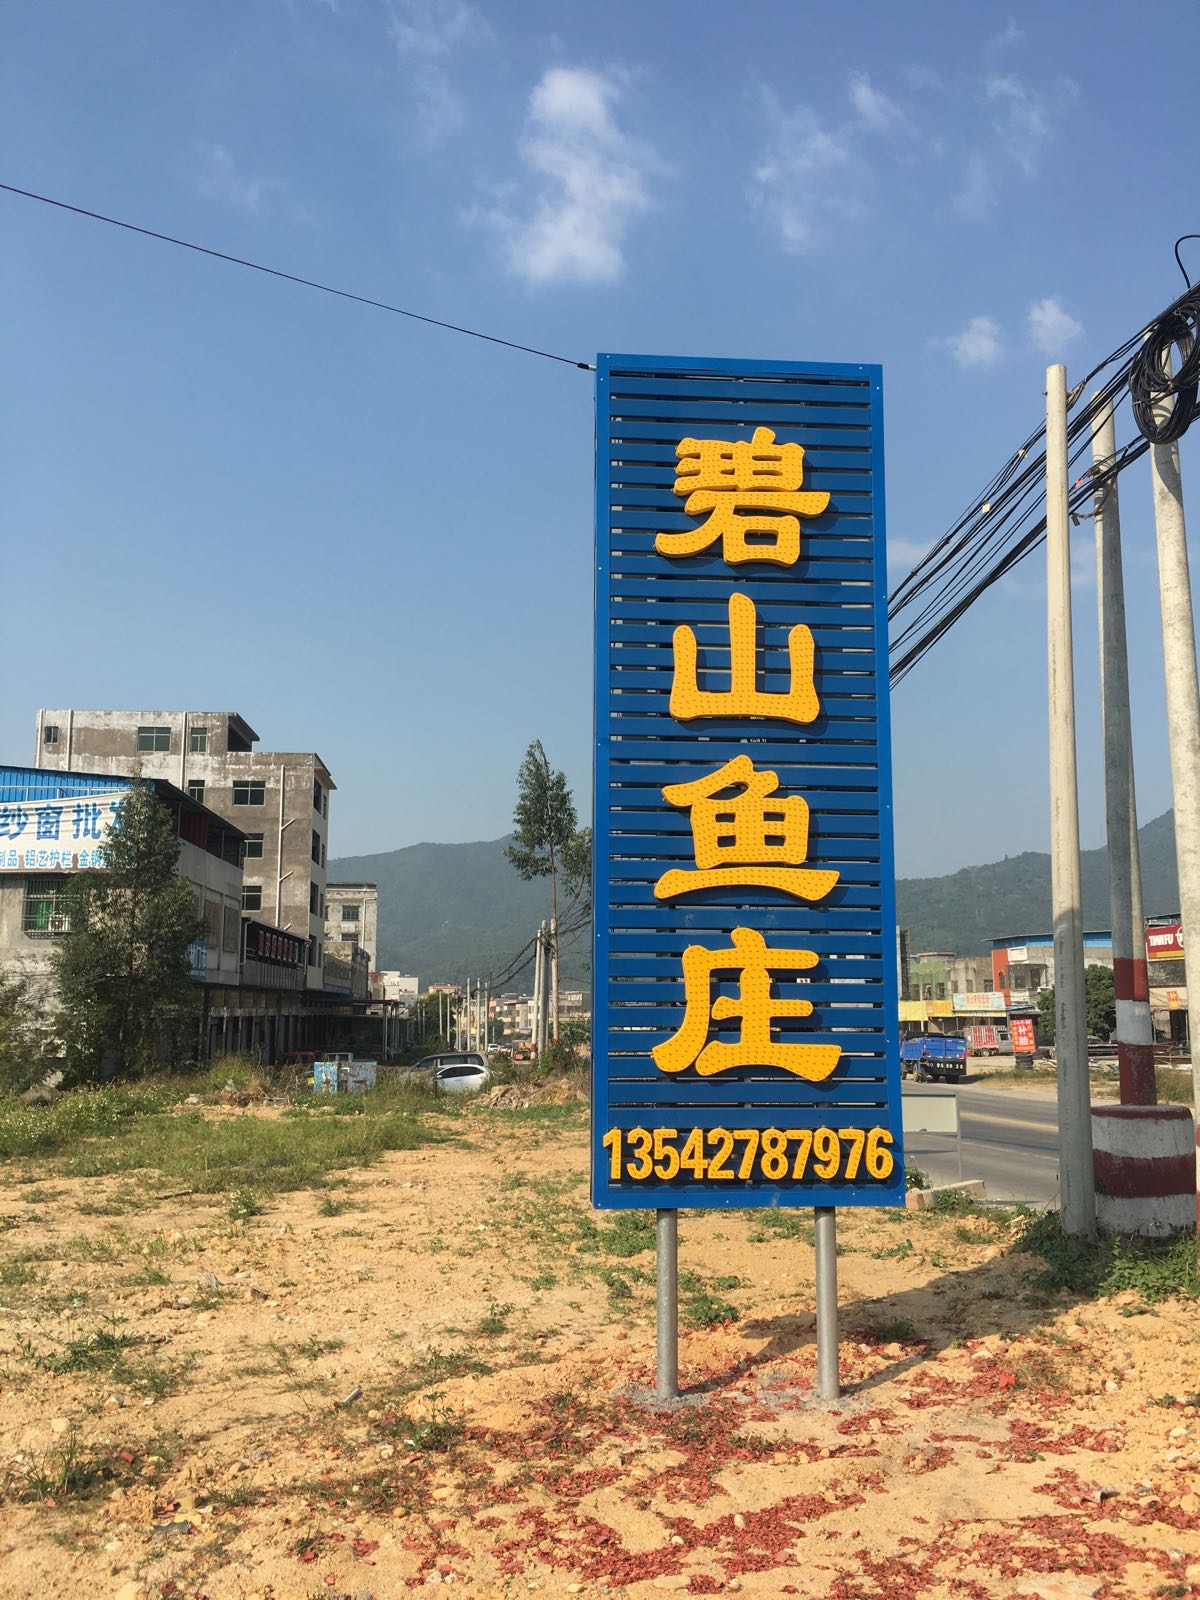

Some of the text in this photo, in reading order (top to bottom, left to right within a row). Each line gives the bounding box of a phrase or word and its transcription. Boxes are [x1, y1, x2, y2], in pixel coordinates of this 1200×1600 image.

[652, 427, 842, 1083] 碧山鱼庄
[602, 1126, 895, 1182] 13542787976
